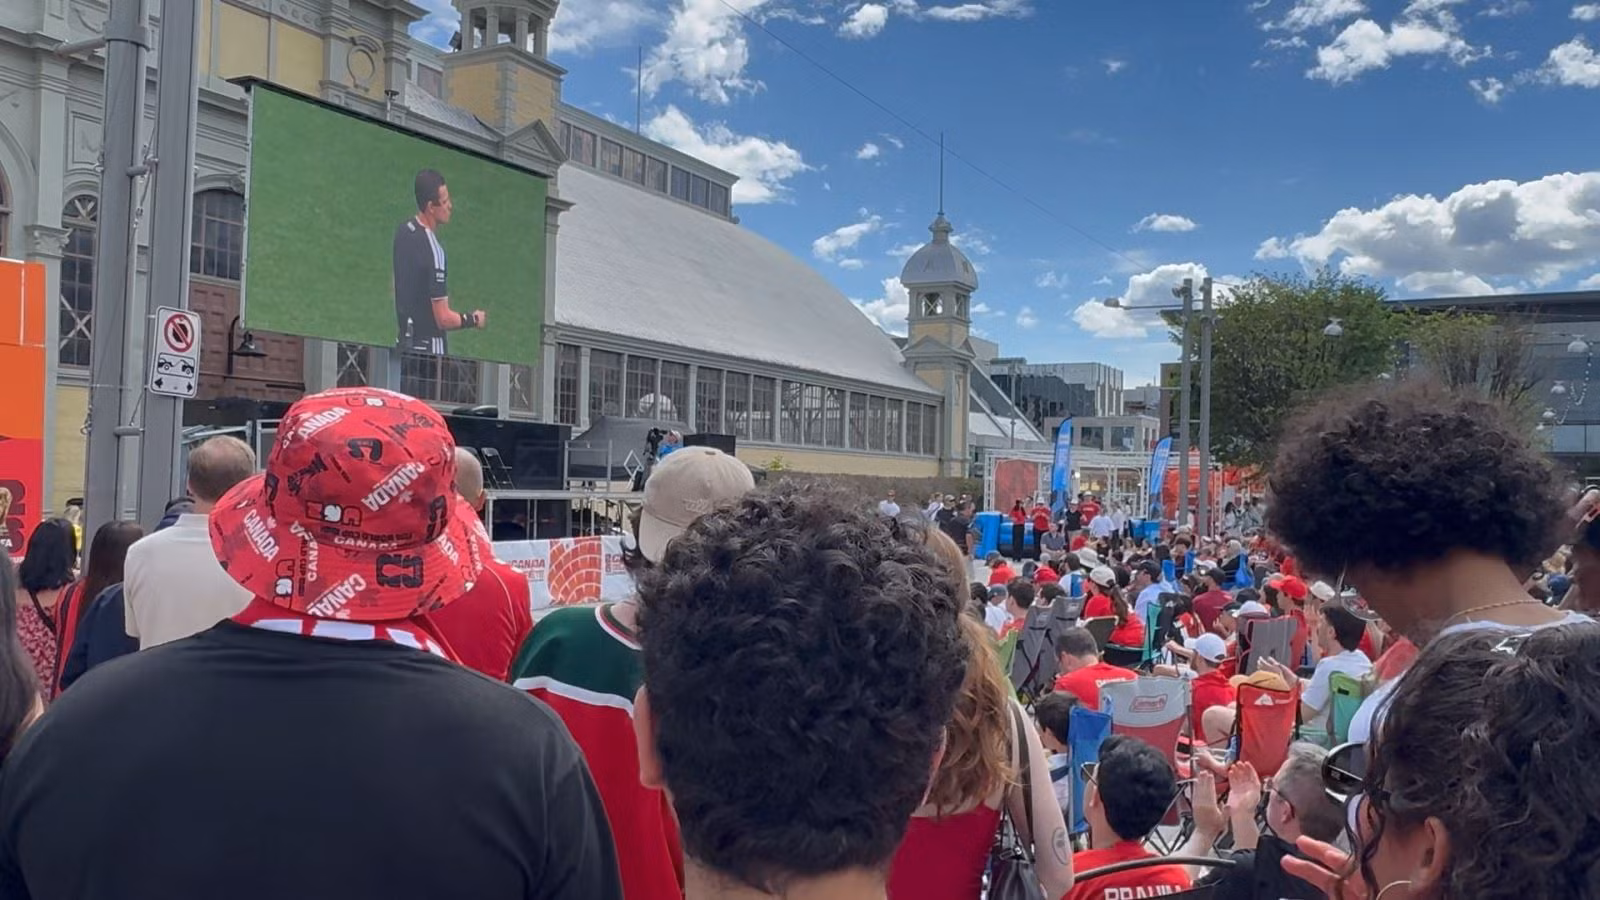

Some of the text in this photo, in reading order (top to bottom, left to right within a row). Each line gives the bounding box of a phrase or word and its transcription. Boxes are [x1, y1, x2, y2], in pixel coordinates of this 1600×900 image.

[297, 406, 353, 439] ANADA
[361, 461, 425, 512] CANADA
[243, 508, 280, 562] CANADA
[436, 533, 459, 566] ADA
[307, 573, 367, 618] CANA
